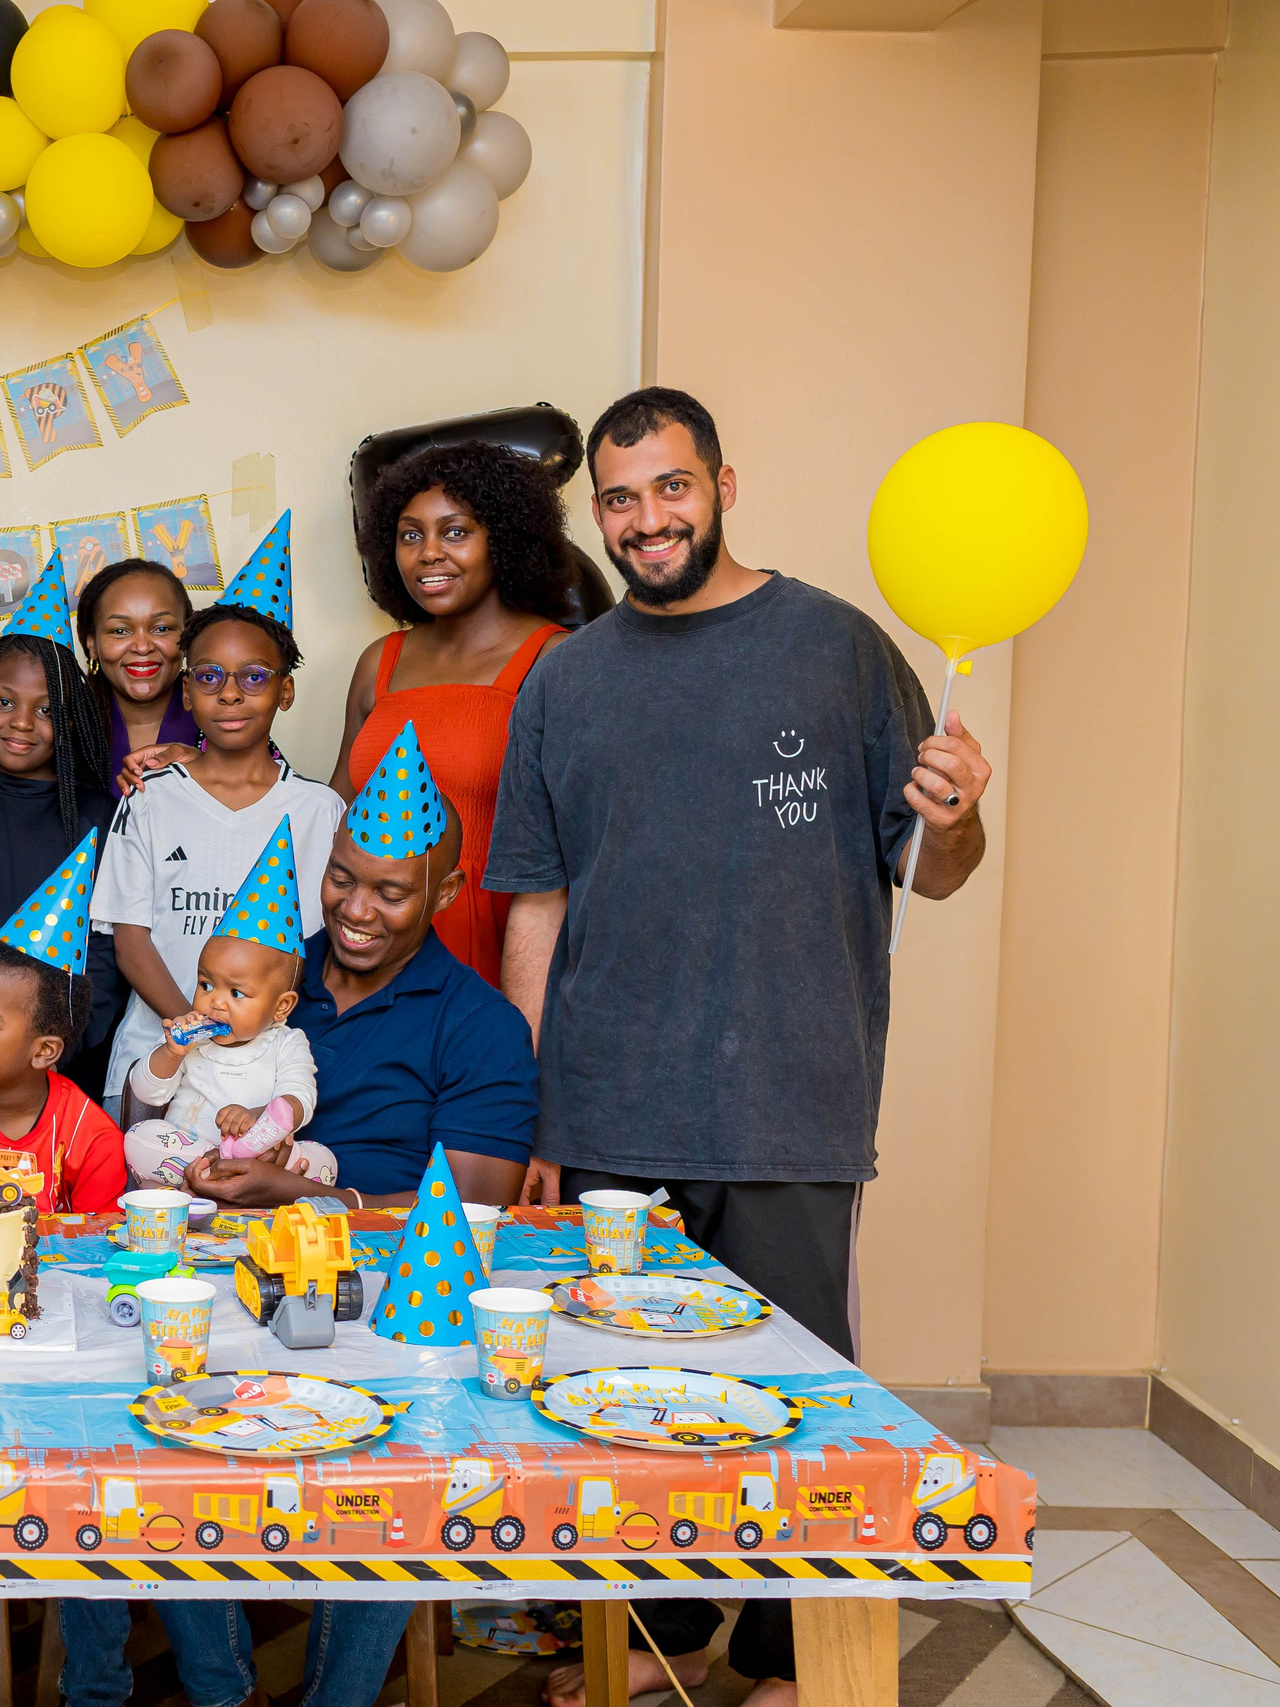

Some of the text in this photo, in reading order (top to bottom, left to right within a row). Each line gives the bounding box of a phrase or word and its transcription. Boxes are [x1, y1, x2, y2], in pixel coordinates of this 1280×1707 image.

[752, 767, 827, 807] THANK
[775, 801, 817, 829] YOU
[171, 887, 235, 911] Emir
[183, 915, 208, 935] FLY
[167, 1308, 212, 1325] HAPP
[149, 1321, 210, 1338] BIRTHD
[501, 1317, 548, 1334] HAPP
[482, 1332, 546, 1349] BIRTHD
[596, 1378, 687, 1397] HAPPY
[567, 1390, 729, 1406] BIRTHDAY
[335, 1495, 380, 1507] UNDER
[809, 1491, 852, 1504] UNDER
